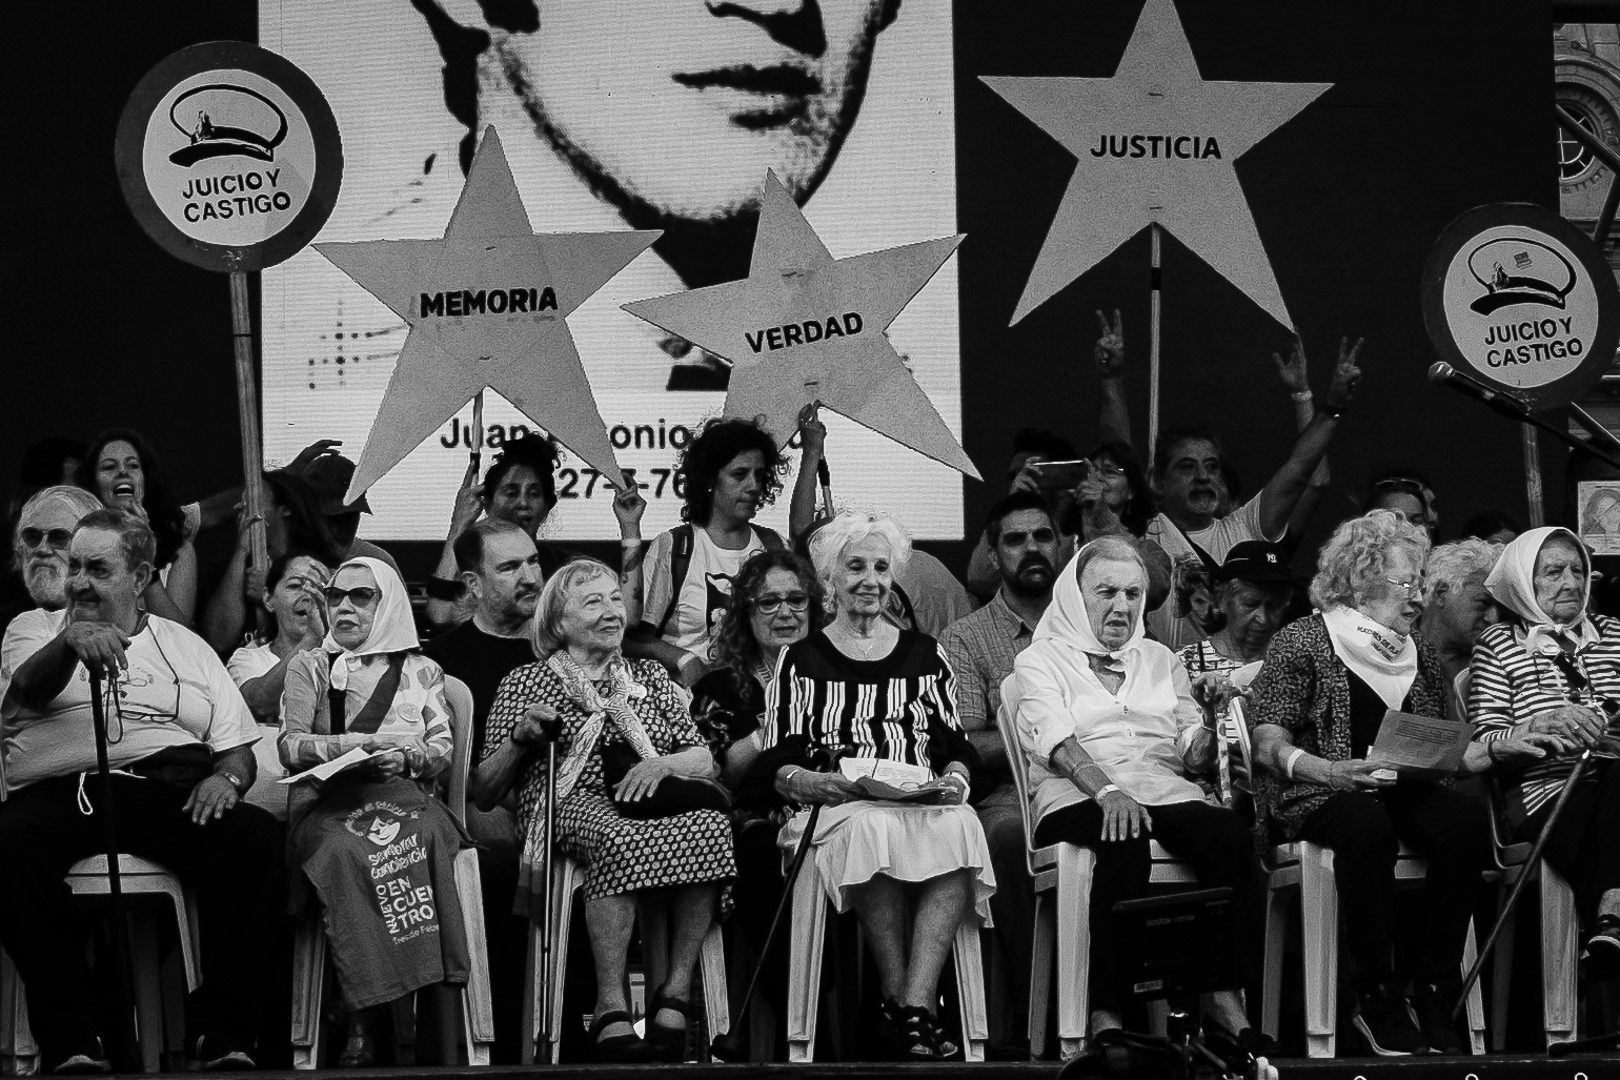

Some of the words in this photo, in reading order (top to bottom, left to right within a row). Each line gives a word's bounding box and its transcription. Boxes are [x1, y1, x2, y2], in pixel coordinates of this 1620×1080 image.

[1090, 134, 1222, 160] JUSTICIA
[182, 172, 263, 199] JUICIO
[266, 168, 280, 188] Y
[183, 191, 291, 222] CASTIGO
[420, 286, 558, 319] MEMORIA
[745, 311, 863, 353] VERDAD
[1485, 318, 1557, 345] JUICIO
[1558, 316, 1572, 334] Y
[1487, 338, 1582, 367] CASTIGO
[387, 876, 411, 896] EN
[376, 884, 400, 934] NUEVO
[397, 904, 434, 930] TRO
